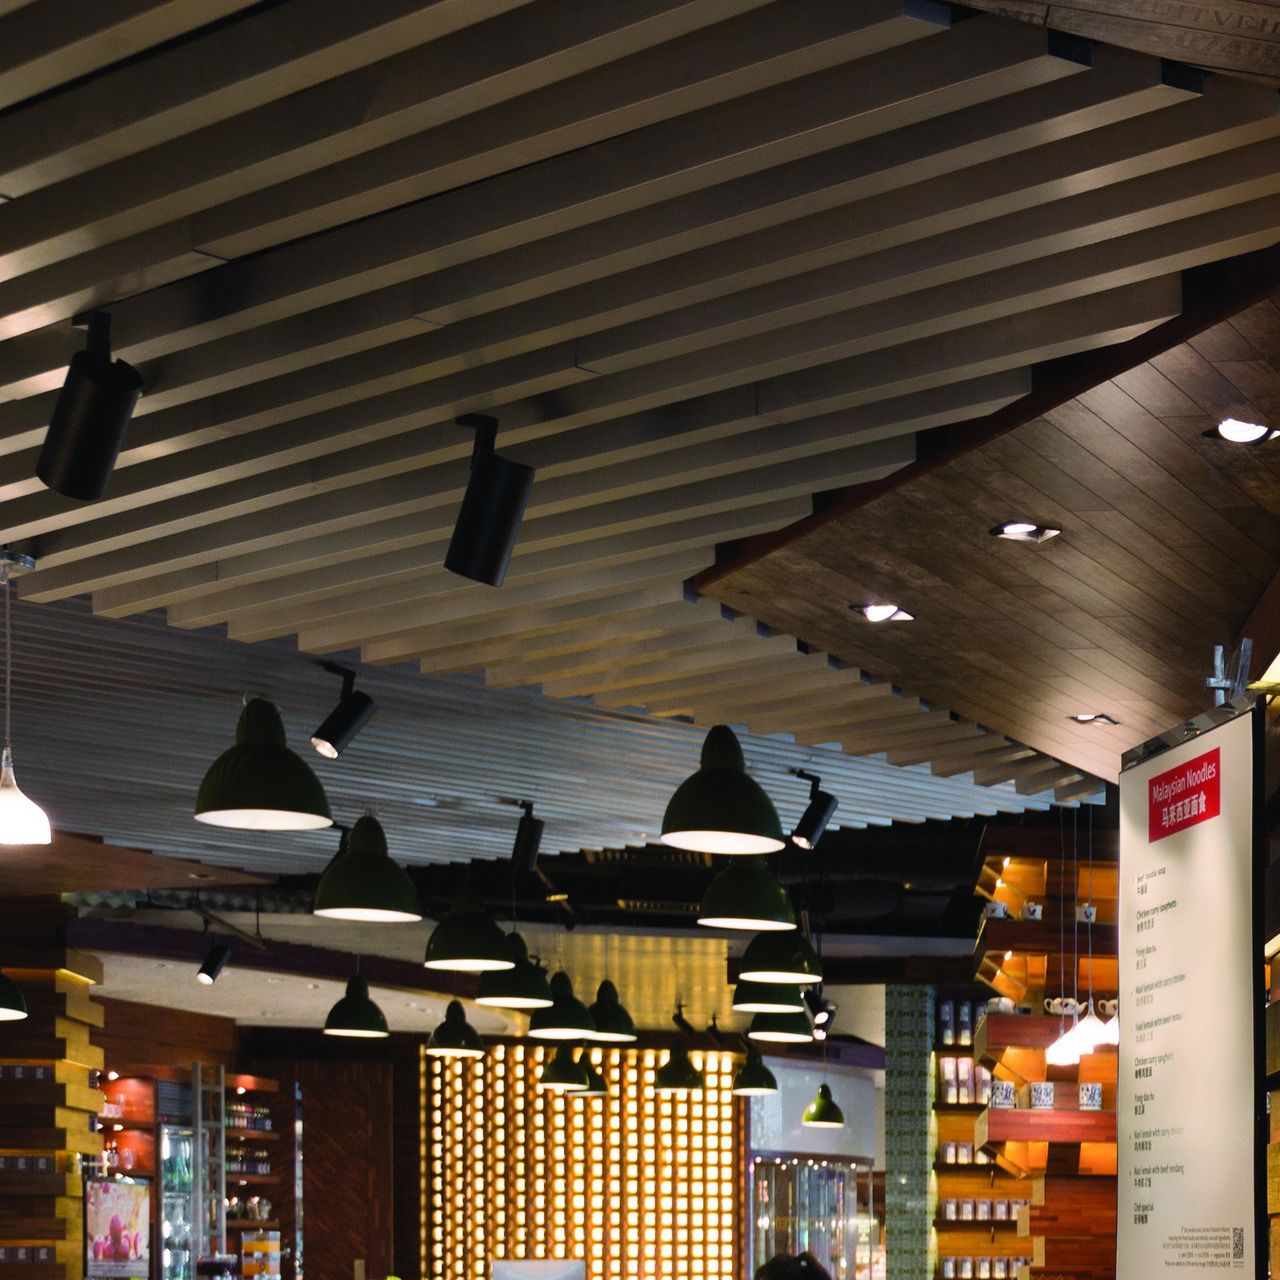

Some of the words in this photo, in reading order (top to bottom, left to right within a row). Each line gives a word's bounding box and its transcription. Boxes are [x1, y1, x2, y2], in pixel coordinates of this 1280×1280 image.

[1153, 776, 1186, 804] Malaysian
[1187, 762, 1216, 789] Noodles
[1162, 790, 1206, 829] 马来西亚面食
